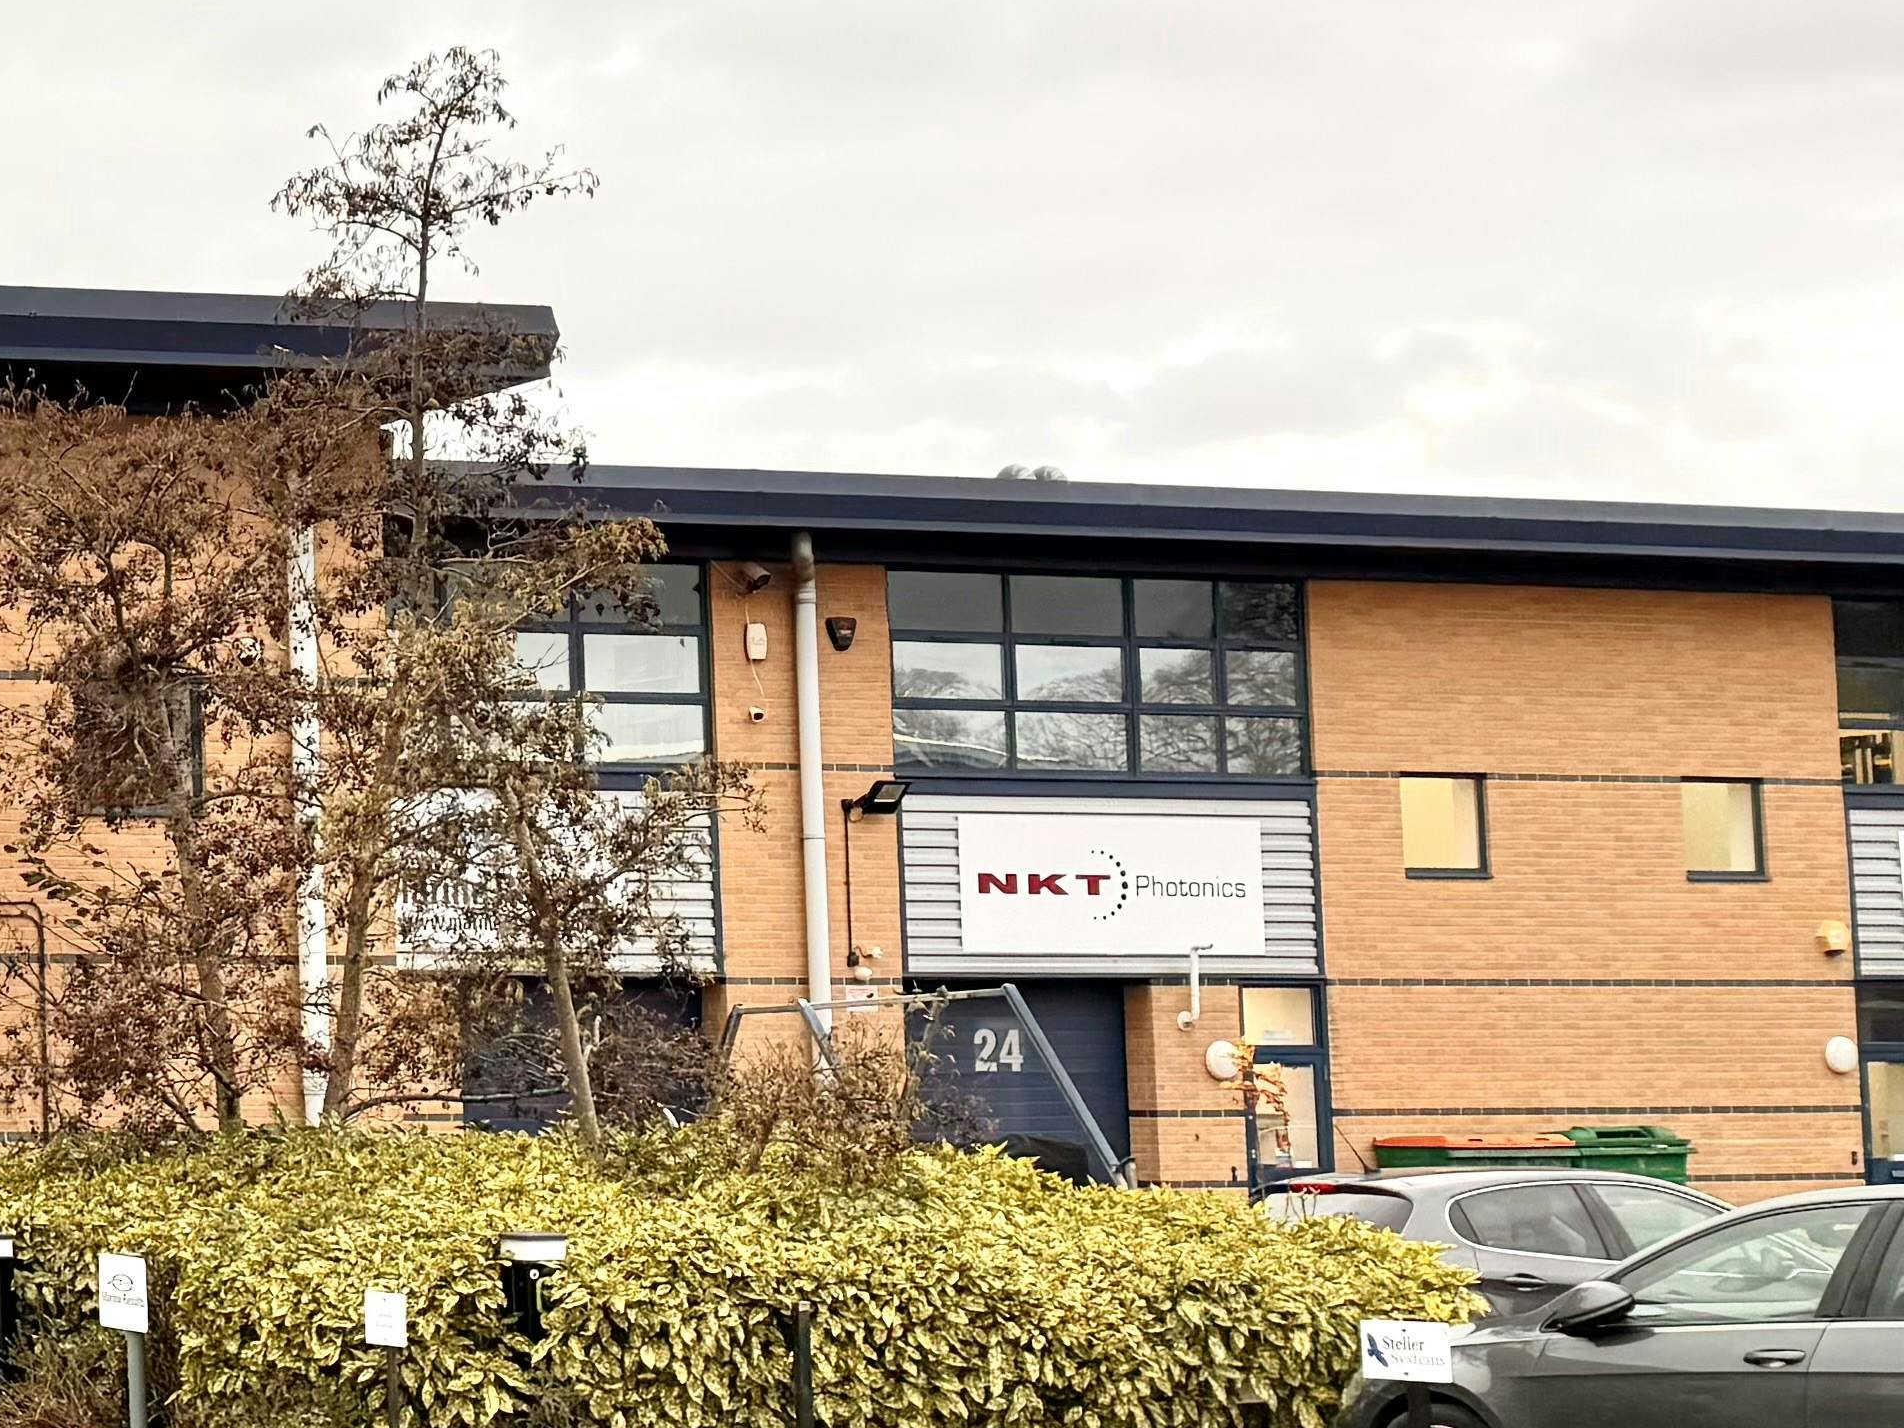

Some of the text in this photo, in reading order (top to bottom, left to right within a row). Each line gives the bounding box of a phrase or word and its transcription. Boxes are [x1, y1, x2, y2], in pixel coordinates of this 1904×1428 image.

[976, 872, 1247, 899] NKT Photonics
[973, 1028, 1024, 1072] 24
[1382, 1335, 1424, 1351] Steller
